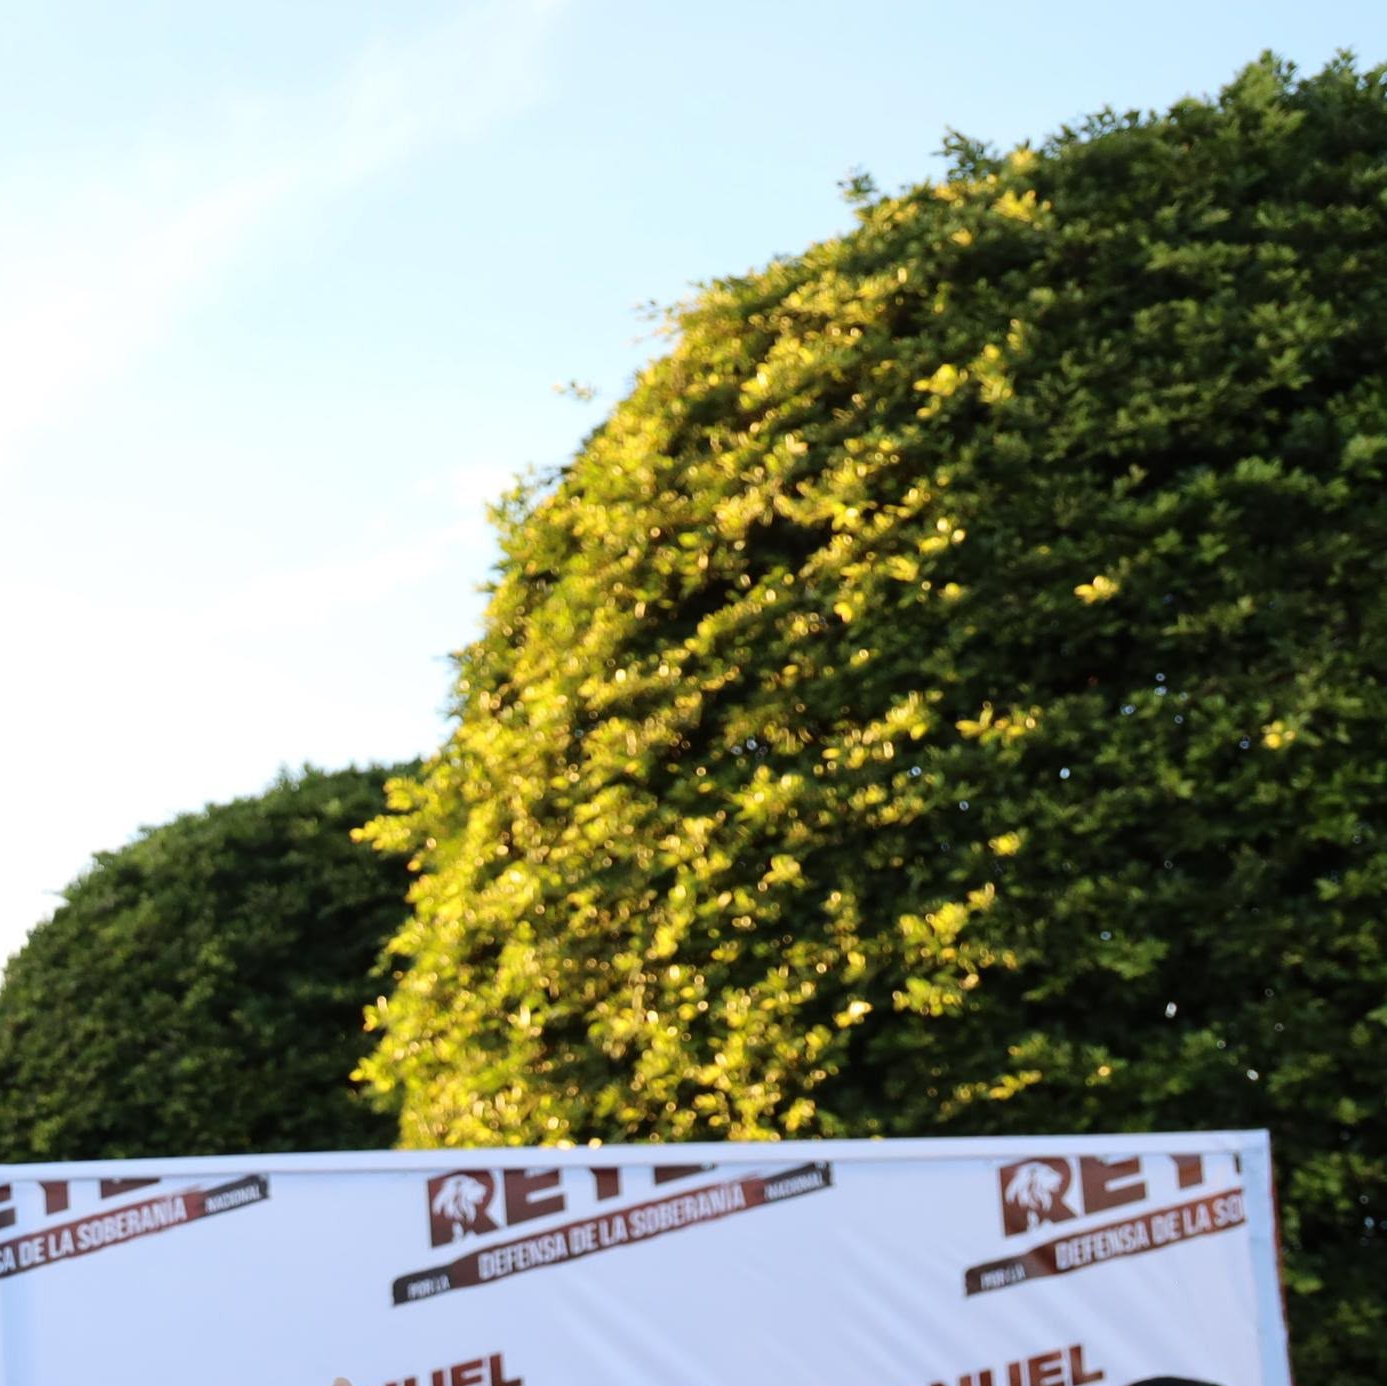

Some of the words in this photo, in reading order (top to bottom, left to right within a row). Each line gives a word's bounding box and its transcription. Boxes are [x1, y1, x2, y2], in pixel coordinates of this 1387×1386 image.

[19, 1237, 45, 1265] DE
[48, 1230, 76, 1259] LA
[77, 1195, 187, 1251] SOBERANÍA
[478, 1233, 568, 1280] DEFENSA
[569, 1222, 598, 1255] DE
[599, 1215, 628, 1246] LA
[629, 1181, 745, 1238] SOBERANÍA
[1055, 1221, 1151, 1270] DEFENSA
[1151, 1214, 1181, 1244] DE
[1183, 1203, 1212, 1234] LA
